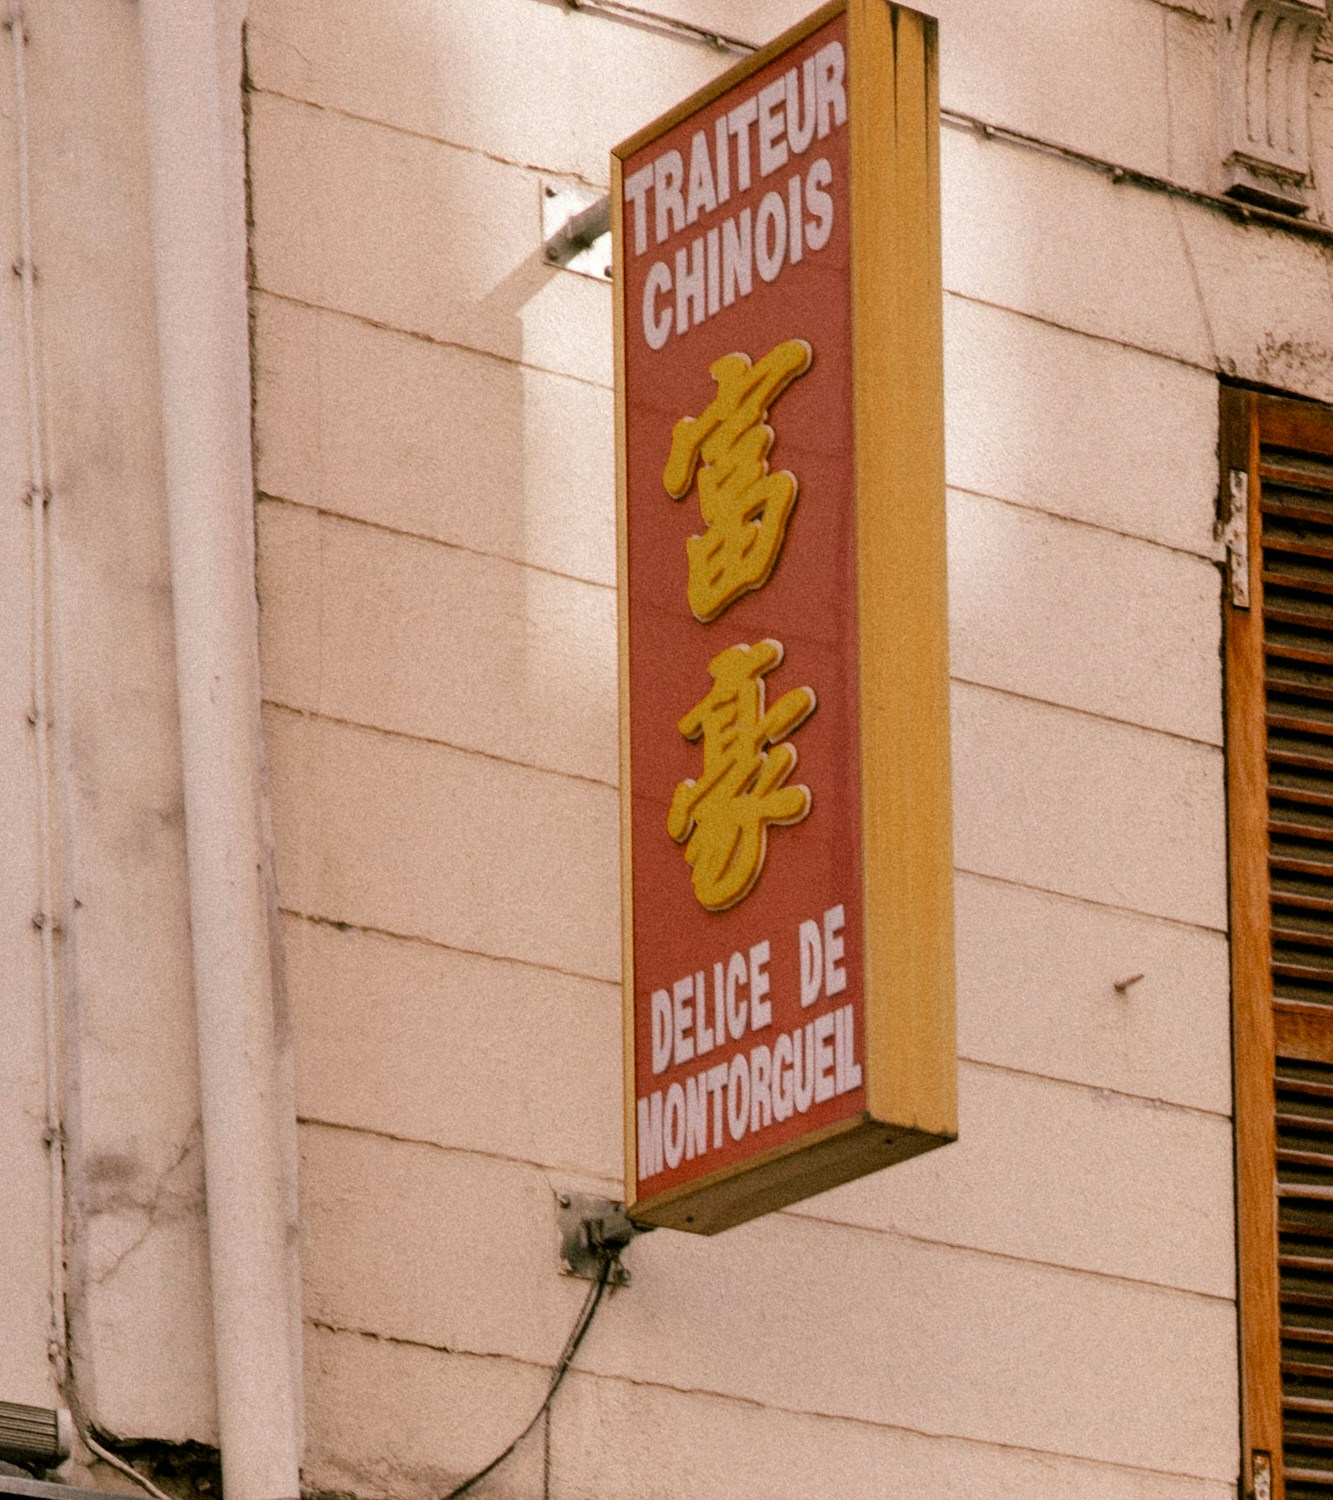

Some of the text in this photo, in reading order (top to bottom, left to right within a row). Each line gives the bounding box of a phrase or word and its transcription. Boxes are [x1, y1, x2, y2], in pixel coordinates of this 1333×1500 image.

[623, 40, 848, 256] TRAITEUR
[642, 157, 835, 350] CHINOIS
[651, 903, 848, 1075] DELICE DE
[637, 1003, 862, 1182] MONTORGUEIL
